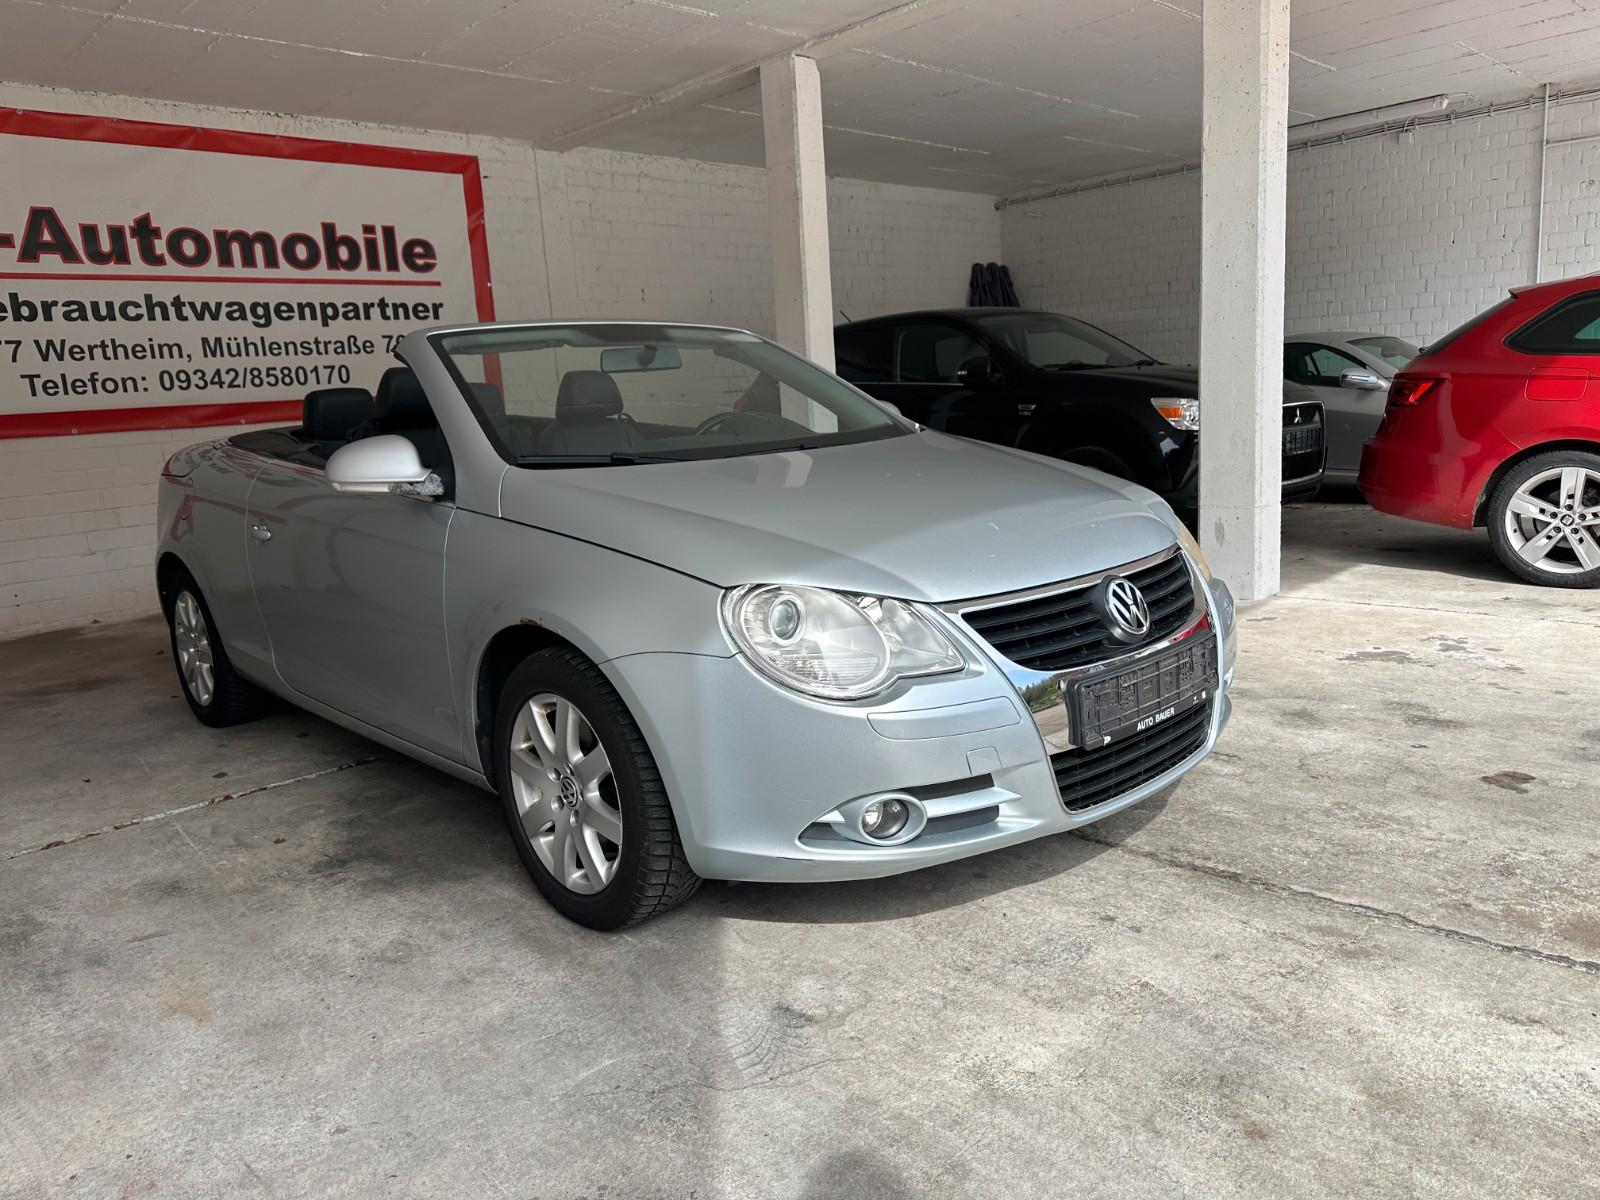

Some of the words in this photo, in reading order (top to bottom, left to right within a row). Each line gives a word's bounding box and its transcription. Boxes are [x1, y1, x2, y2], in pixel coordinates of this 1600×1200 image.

[0, 339, 22, 363] 7
[33, 338, 192, 363] Wertheim,
[201, 334, 375, 358] Mühlenstraße
[20, 371, 149, 397] Telefon:
[159, 365, 351, 391] 09342/8580170
[1137, 717, 1154, 731] AUTO
[1155, 707, 1175, 723] BAUER
